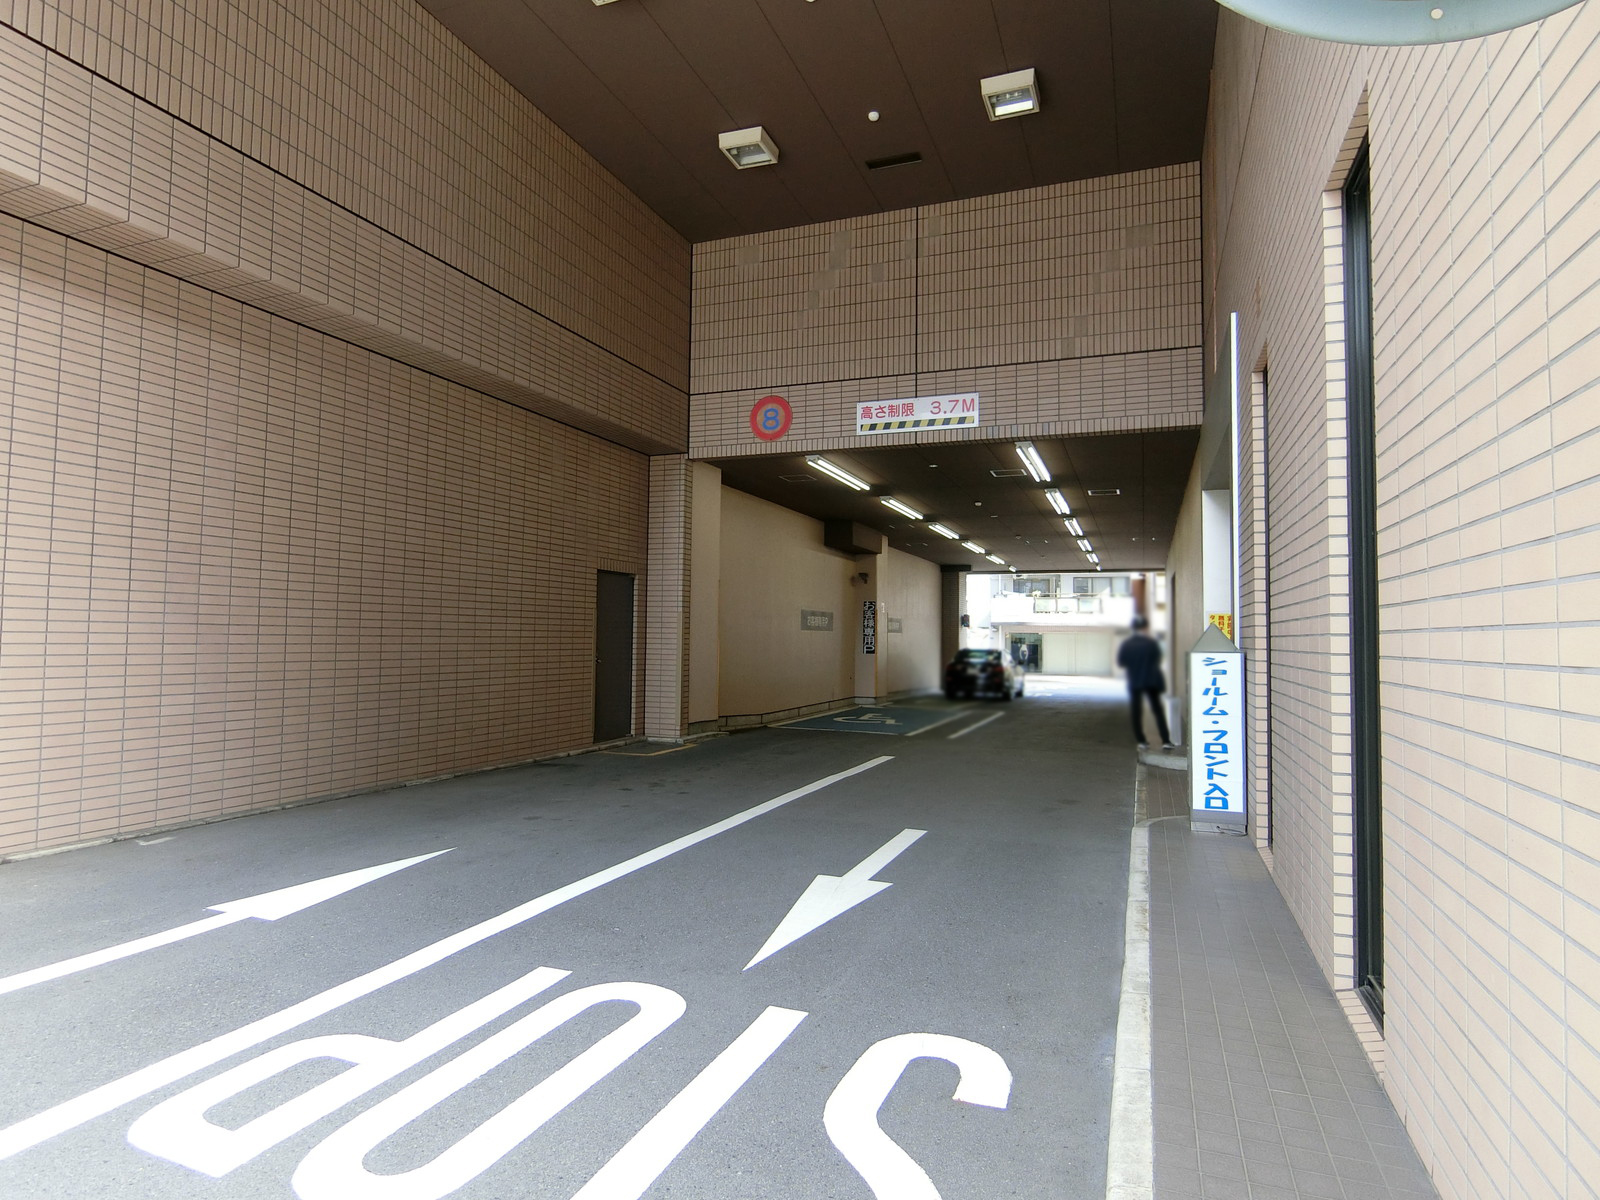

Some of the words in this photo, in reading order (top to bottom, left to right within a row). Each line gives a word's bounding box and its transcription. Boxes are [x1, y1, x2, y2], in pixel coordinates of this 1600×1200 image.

[762, 407, 780, 431] 8
[860, 402, 915, 420] 高さ制限
[930, 397, 975, 415] 3.7M
[1202, 657, 1229, 810] ショールーム・フロント入口
